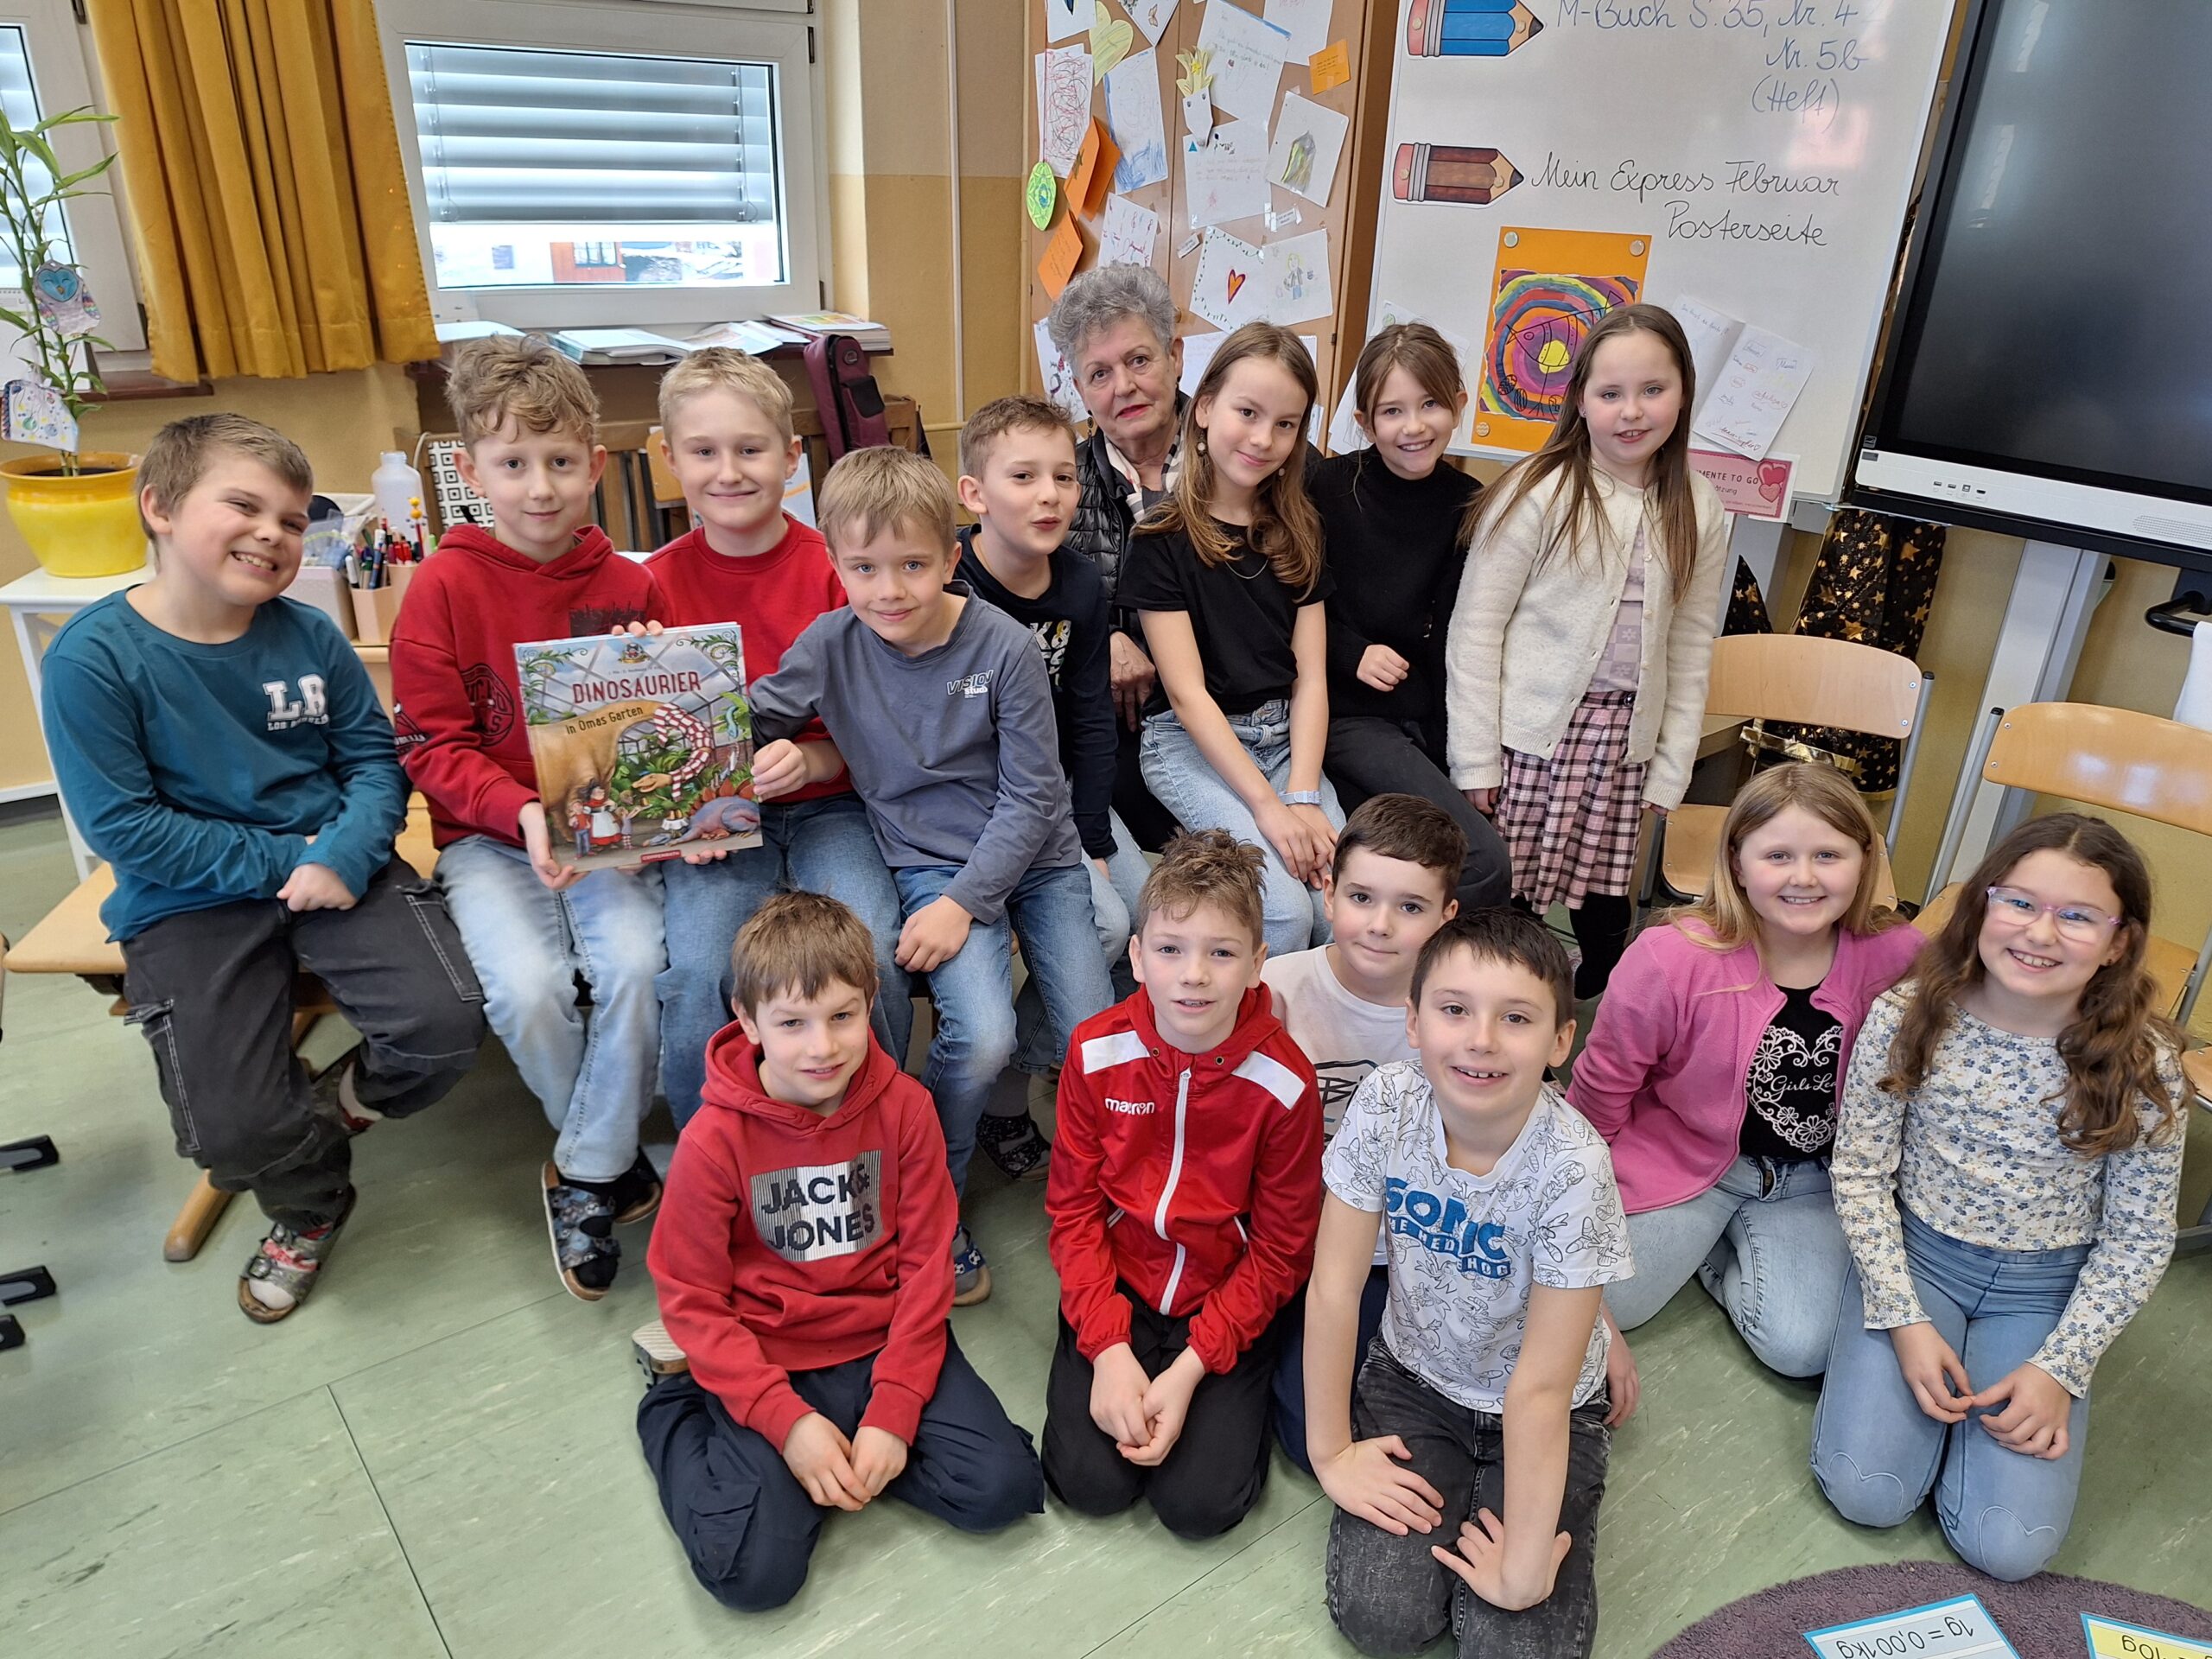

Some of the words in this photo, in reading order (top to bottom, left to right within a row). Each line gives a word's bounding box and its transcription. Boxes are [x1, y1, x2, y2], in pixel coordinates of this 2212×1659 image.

[1557, 0, 1677, 29] M-Buch
[1777, 0, 1825, 28] Nr.
[1834, 0, 1859, 28] 4
[1766, 37, 1808, 71] Nr.
[1816, 39, 1871, 71] 5b
[1751, 74, 1840, 135] (Heft)
[1531, 151, 1599, 188] Mein
[1610, 160, 1714, 204] Express
[1725, 161, 1840, 196] Februar
[1664, 200, 1828, 246] Posterseite
[1731, 474, 1743, 483] TO
[1746, 476, 1759, 485] GO
[572, 671, 702, 704] DINOSAURIER
[566, 724, 576, 735] in
[578, 716, 607, 733] Omas
[609, 705, 645, 723] Garten
[1770, 1075, 1812, 1096] Girls
[767, 1202, 875, 1251] JONES
[1386, 1176, 1508, 1260] SONIC
[1388, 1217, 1409, 1232] HE
[1417, 1230, 1510, 1278] HEDEHOG
[1944, 1616, 1974, 1637] 1g
